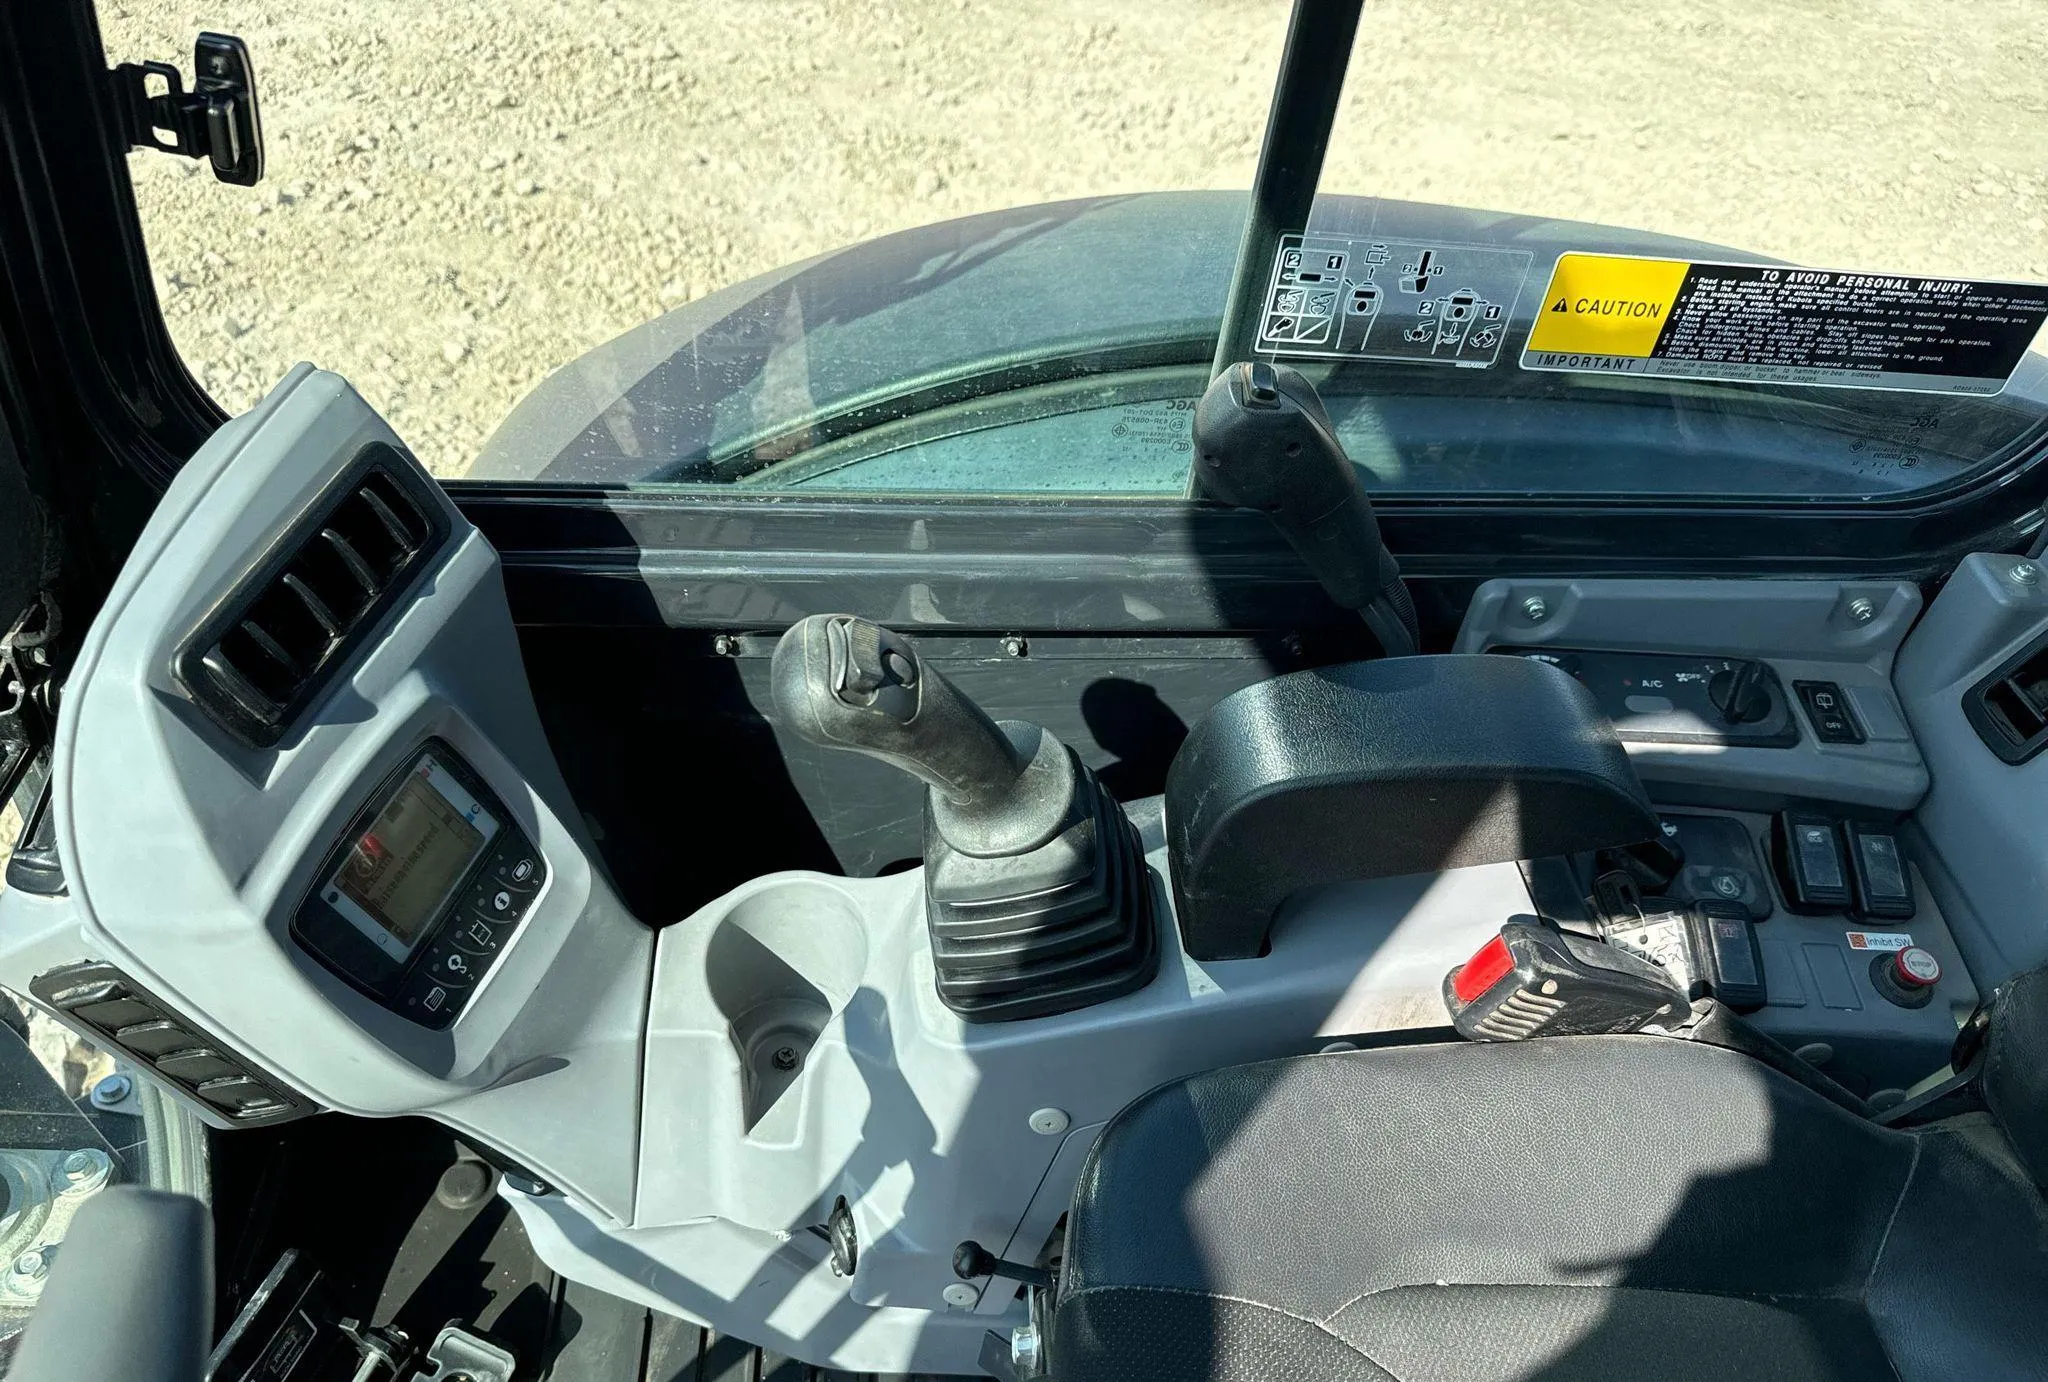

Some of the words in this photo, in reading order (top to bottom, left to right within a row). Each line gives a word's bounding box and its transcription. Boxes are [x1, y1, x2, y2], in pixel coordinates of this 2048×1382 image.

[1289, 254, 1300, 266] 2
[1330, 256, 1338, 268] 1
[1761, 270, 1779, 281] TO
[1785, 272, 1830, 284] AVOID
[1836, 275, 1909, 290] PERSONAL
[1917, 280, 1972, 293] INJURY:
[1781, 283, 1820, 292] operator's
[1880, 289, 1918, 298] attempting
[1717, 298, 1746, 306] starting
[1421, 302, 1432, 313] 2
[1488, 307, 1497, 318] 1
[1576, 298, 1662, 318] CAUTION
[1731, 313, 1772, 321] passengers
[1703, 323, 1749, 332] underground
[1698, 341, 1740, 350] dismounting
[1813, 336, 1847, 345] drop-offs
[1816, 343, 1848, 351] securely
[1538, 354, 1635, 370] IMPORTANT
[1810, 361, 1842, 369] repaired
[1866, 938, 1894, 946] Inhibit
